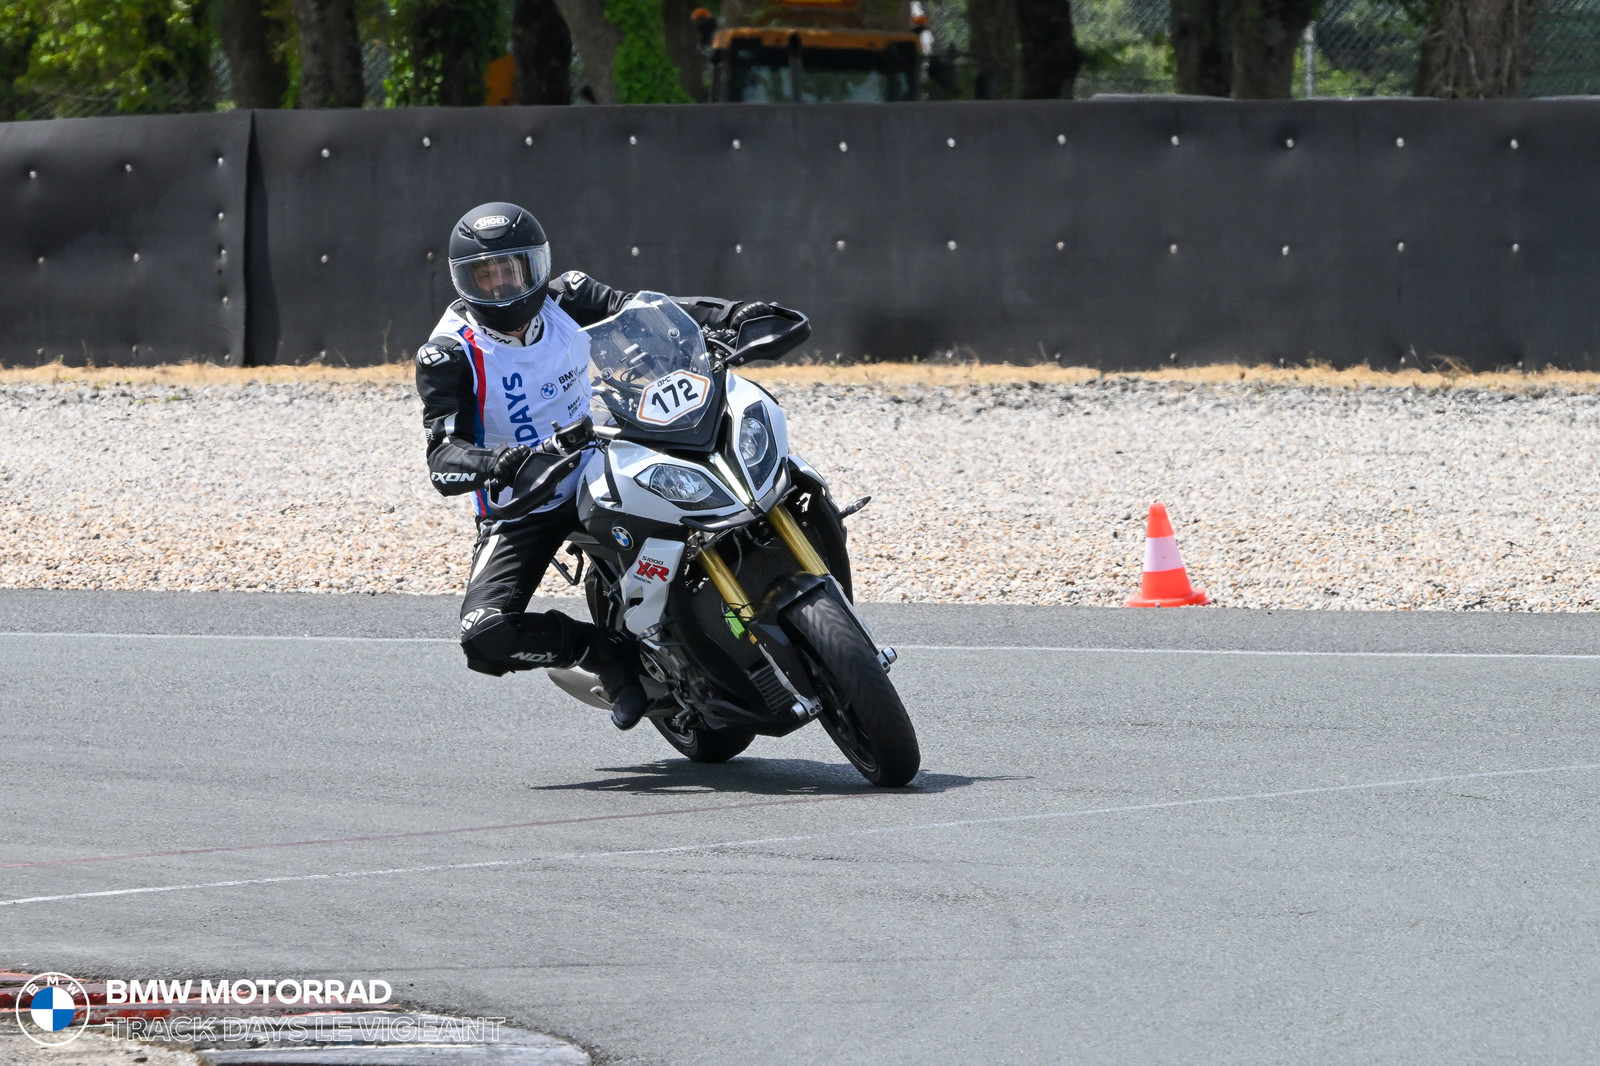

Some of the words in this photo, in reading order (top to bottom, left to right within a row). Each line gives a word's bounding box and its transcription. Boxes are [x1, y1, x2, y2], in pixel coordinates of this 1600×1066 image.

[476, 217, 506, 229] SHOEI
[651, 378, 699, 414] 172
[642, 555, 664, 566] S1000
[636, 559, 670, 582] XR
